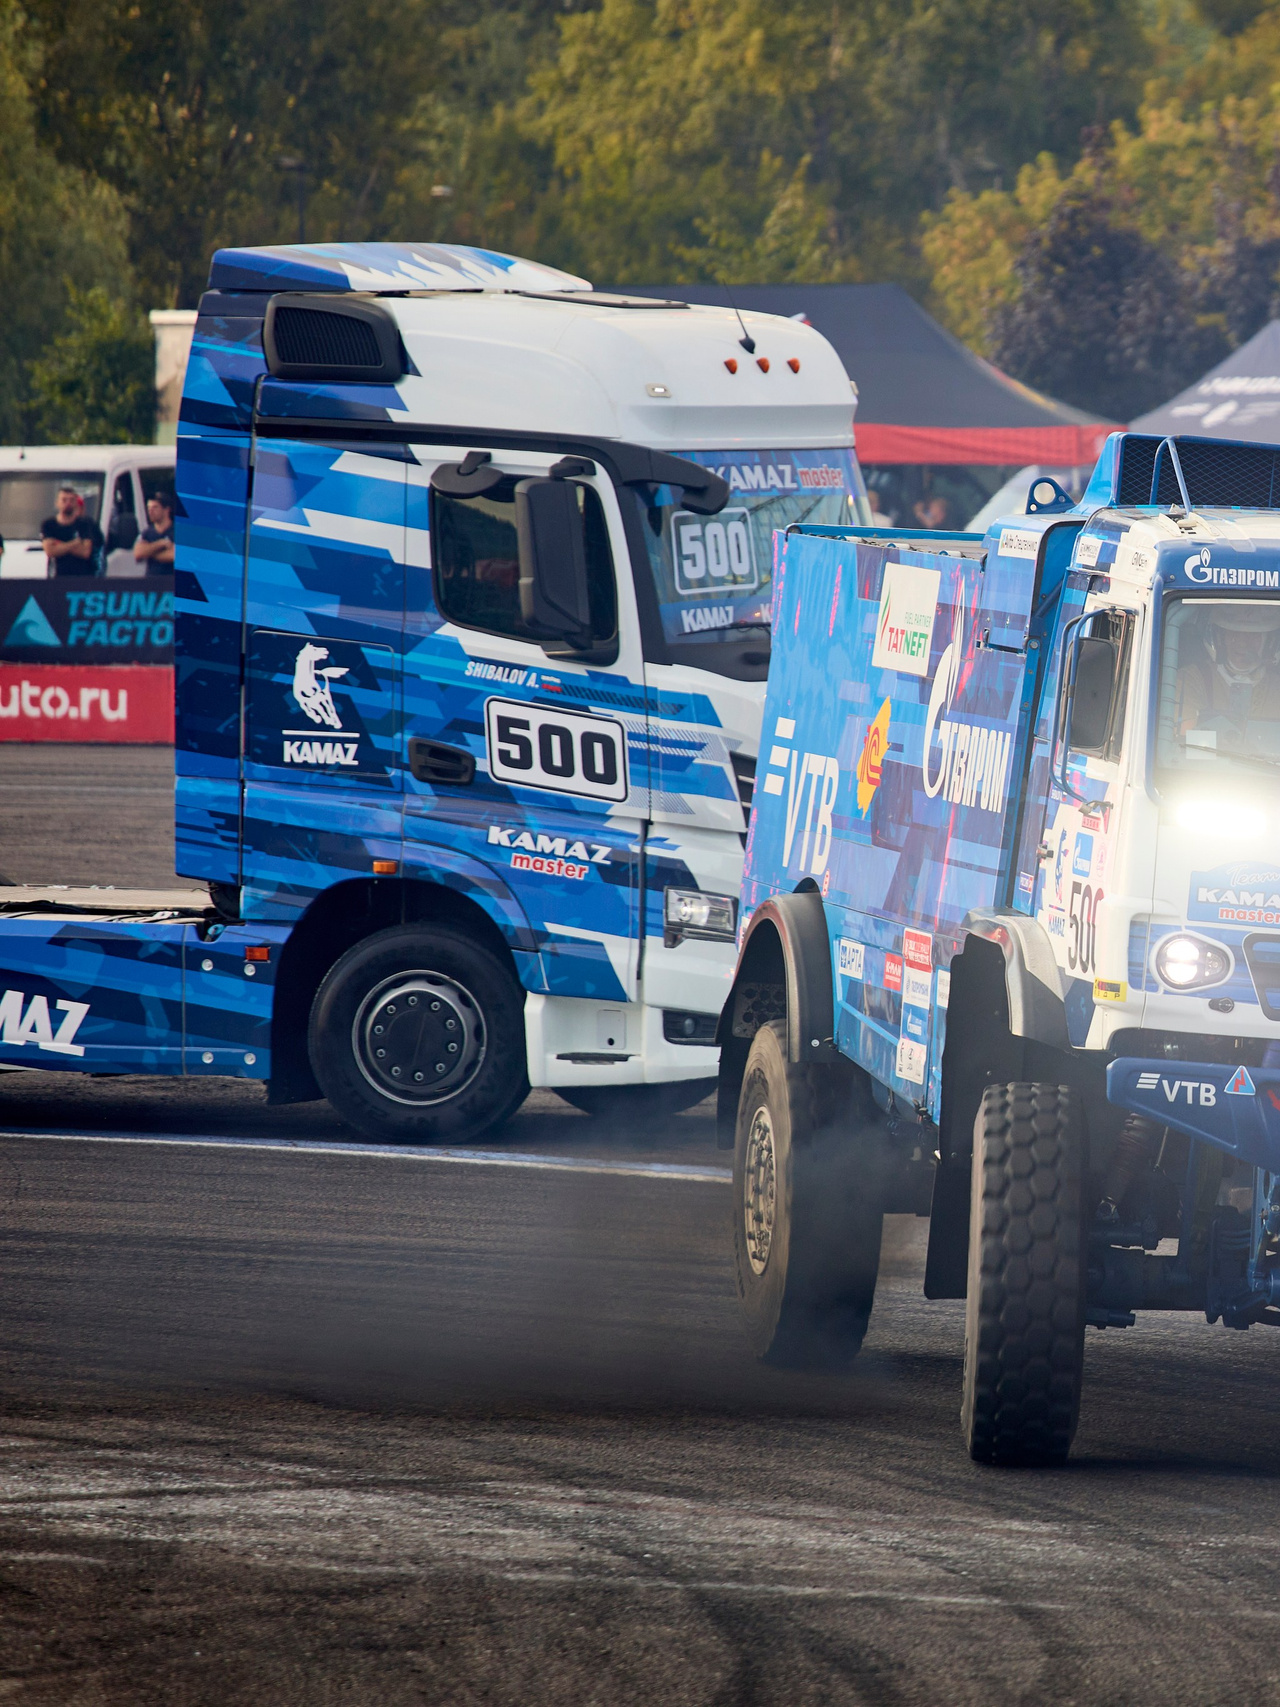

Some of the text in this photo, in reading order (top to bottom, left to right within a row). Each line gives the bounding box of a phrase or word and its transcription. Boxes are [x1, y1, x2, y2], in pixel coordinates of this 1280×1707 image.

[798, 464, 845, 489] master
[680, 520, 751, 580] 500
[1212, 566, 1279, 588] ГАЗПРОМ
[681, 605, 735, 633] KAMAZ
[887, 626, 929, 658] TATNEFT
[464, 661, 527, 687] SHIBALOV
[283, 740, 359, 766] KAMAZ
[496, 714, 618, 786] 500
[942, 720, 1012, 814] ГАЗПРОМ
[782, 749, 840, 877] VTB
[487, 825, 613, 865] KAMAZ
[511, 852, 589, 880] master
[1226, 864, 1280, 887] Team
[1161, 1078, 1217, 1107] VTB
